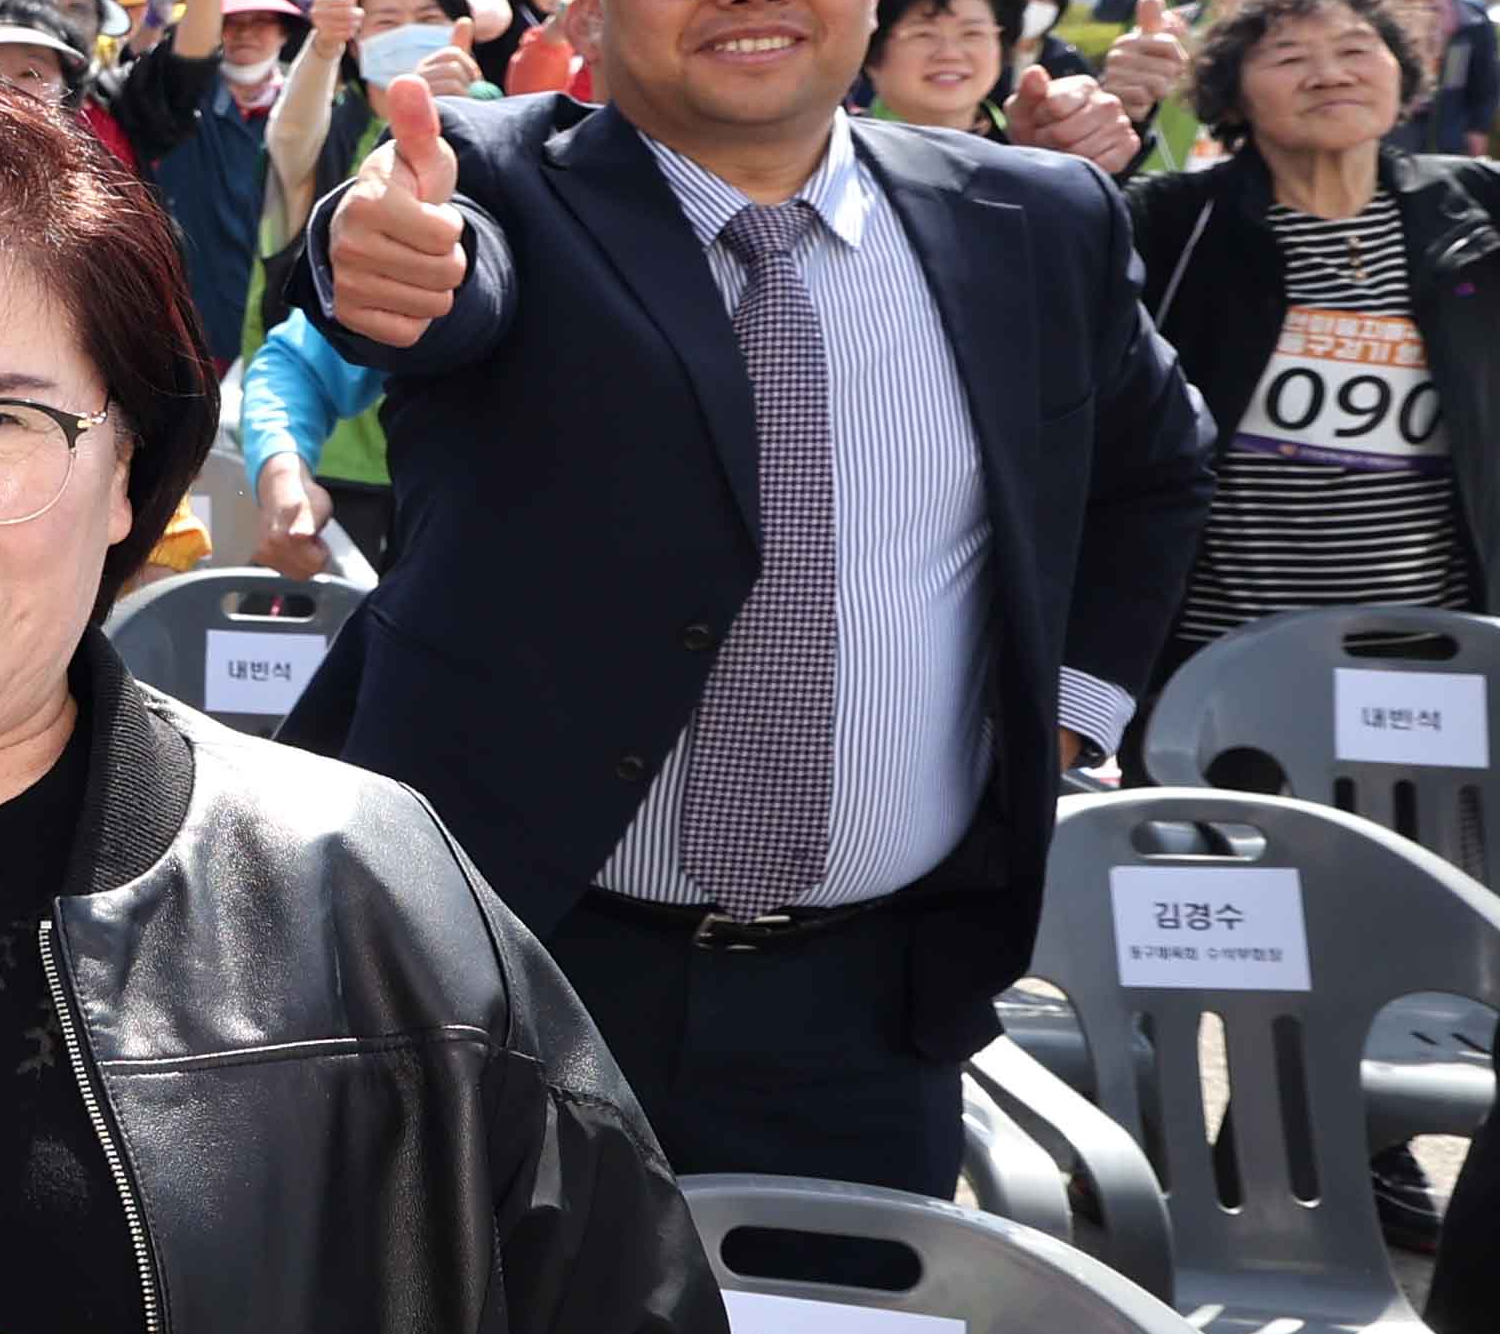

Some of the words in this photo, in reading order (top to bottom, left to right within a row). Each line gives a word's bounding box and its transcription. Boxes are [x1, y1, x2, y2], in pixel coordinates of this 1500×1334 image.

[1265, 367, 1442, 445] 090
[228, 660, 292, 682] 내빈석
[1153, 902, 1245, 931] 김경수
